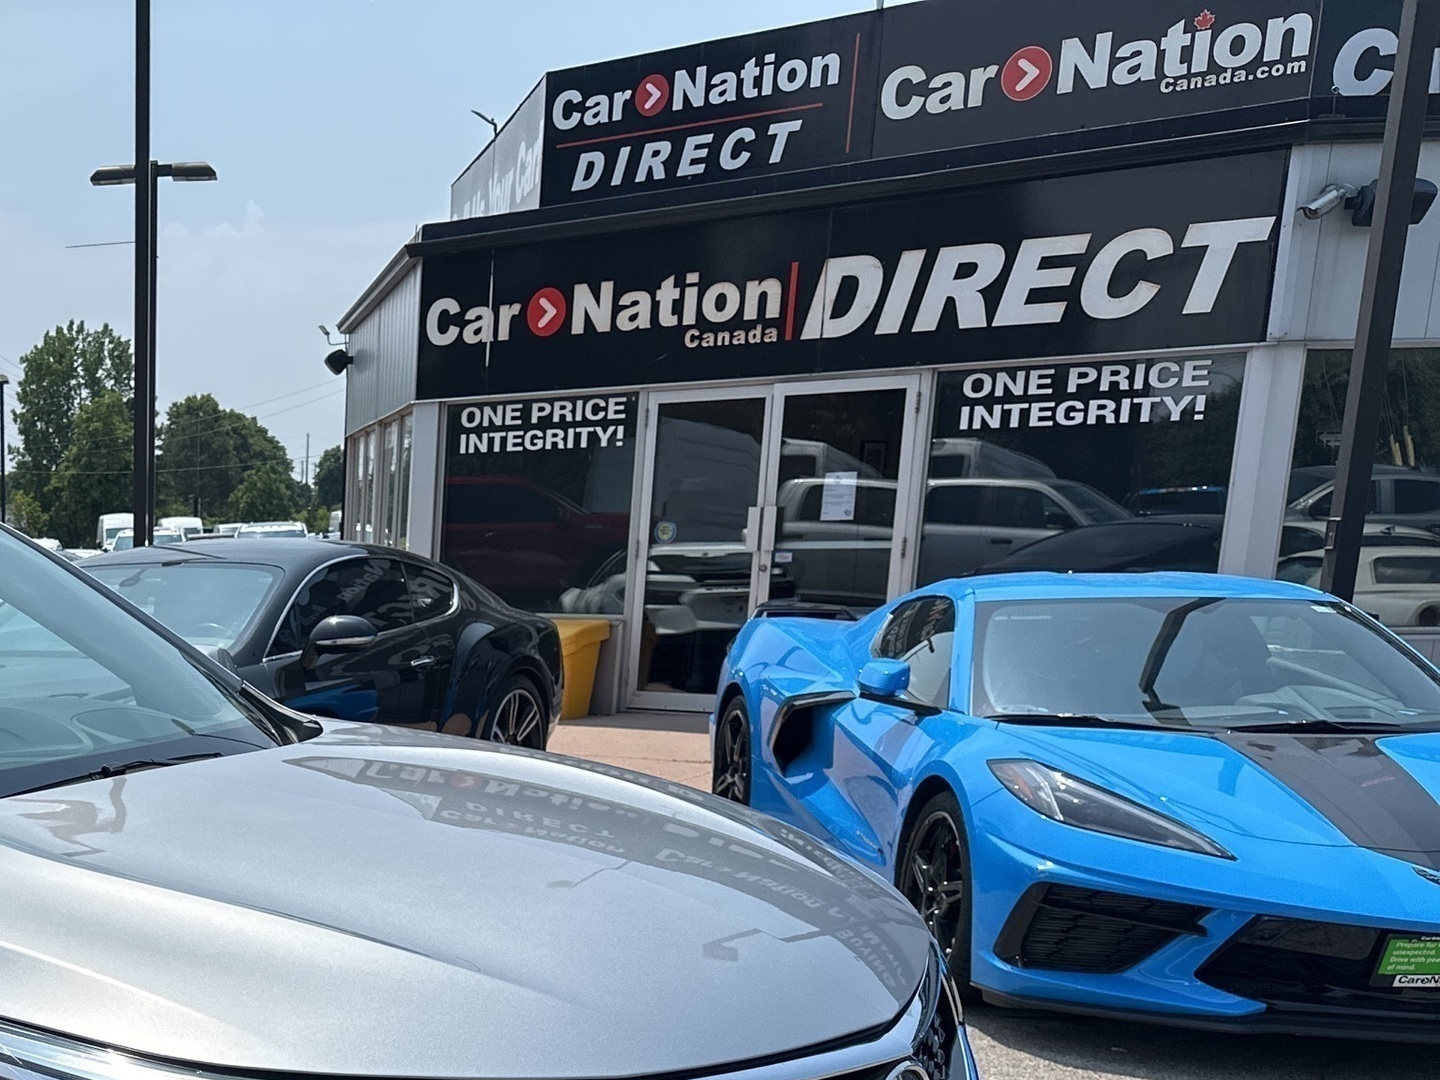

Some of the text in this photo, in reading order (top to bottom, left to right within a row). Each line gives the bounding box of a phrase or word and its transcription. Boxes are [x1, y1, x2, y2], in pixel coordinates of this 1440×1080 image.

[881, 12, 1313, 120] Car Nation
[1160, 61, 1307, 93] Canada.com
[552, 53, 841, 130] Car Nation
[572, 120, 803, 192] DIRECT
[426, 217, 1277, 346] Car Nation DIRECT
[685, 325, 777, 348] Canada
[962, 360, 1212, 398] ONE PRICE
[461, 397, 627, 428] ONE PRICE
[959, 395, 1207, 430] INTEGRITY!
[460, 426, 625, 454] INTEGRITY!
